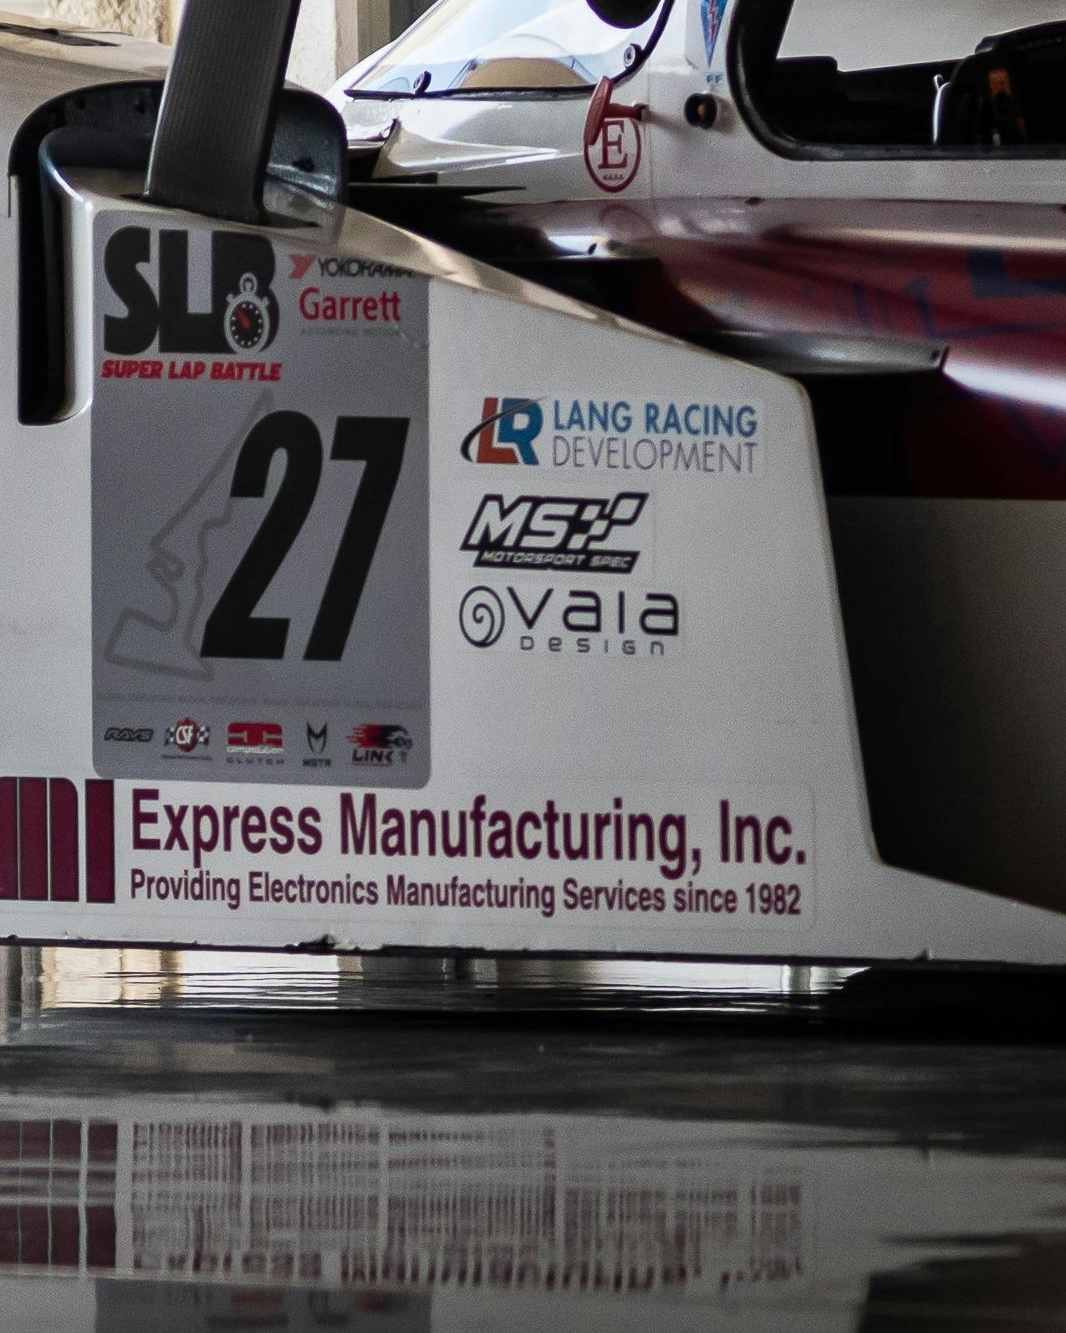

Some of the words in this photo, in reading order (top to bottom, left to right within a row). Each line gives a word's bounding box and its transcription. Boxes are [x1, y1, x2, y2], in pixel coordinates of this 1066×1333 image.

[104, 226, 280, 355] SLB
[298, 286, 401, 322] Garrett
[101, 360, 163, 380] SUPER
[168, 361, 206, 380] LAP
[210, 362, 282, 382] BATTLE
[553, 399, 632, 433] LANG
[645, 402, 758, 438] RACING
[552, 435, 759, 473] DEVELOPMENT
[200, 409, 411, 661] 27
[483, 551, 586, 567] MOTORSPORT
[590, 553, 633, 569] SPEC
[132, 789, 323, 868] Express
[340, 792, 702, 880] Manufacturing,
[719, 799, 806, 865] Inc.
[131, 868, 242, 910] Providing
[249, 871, 379, 906] Electronics
[387, 874, 555, 918] Manufacturing
[563, 878, 666, 913] Services
[673, 881, 737, 914] since
[746, 883, 801, 915] 1982
